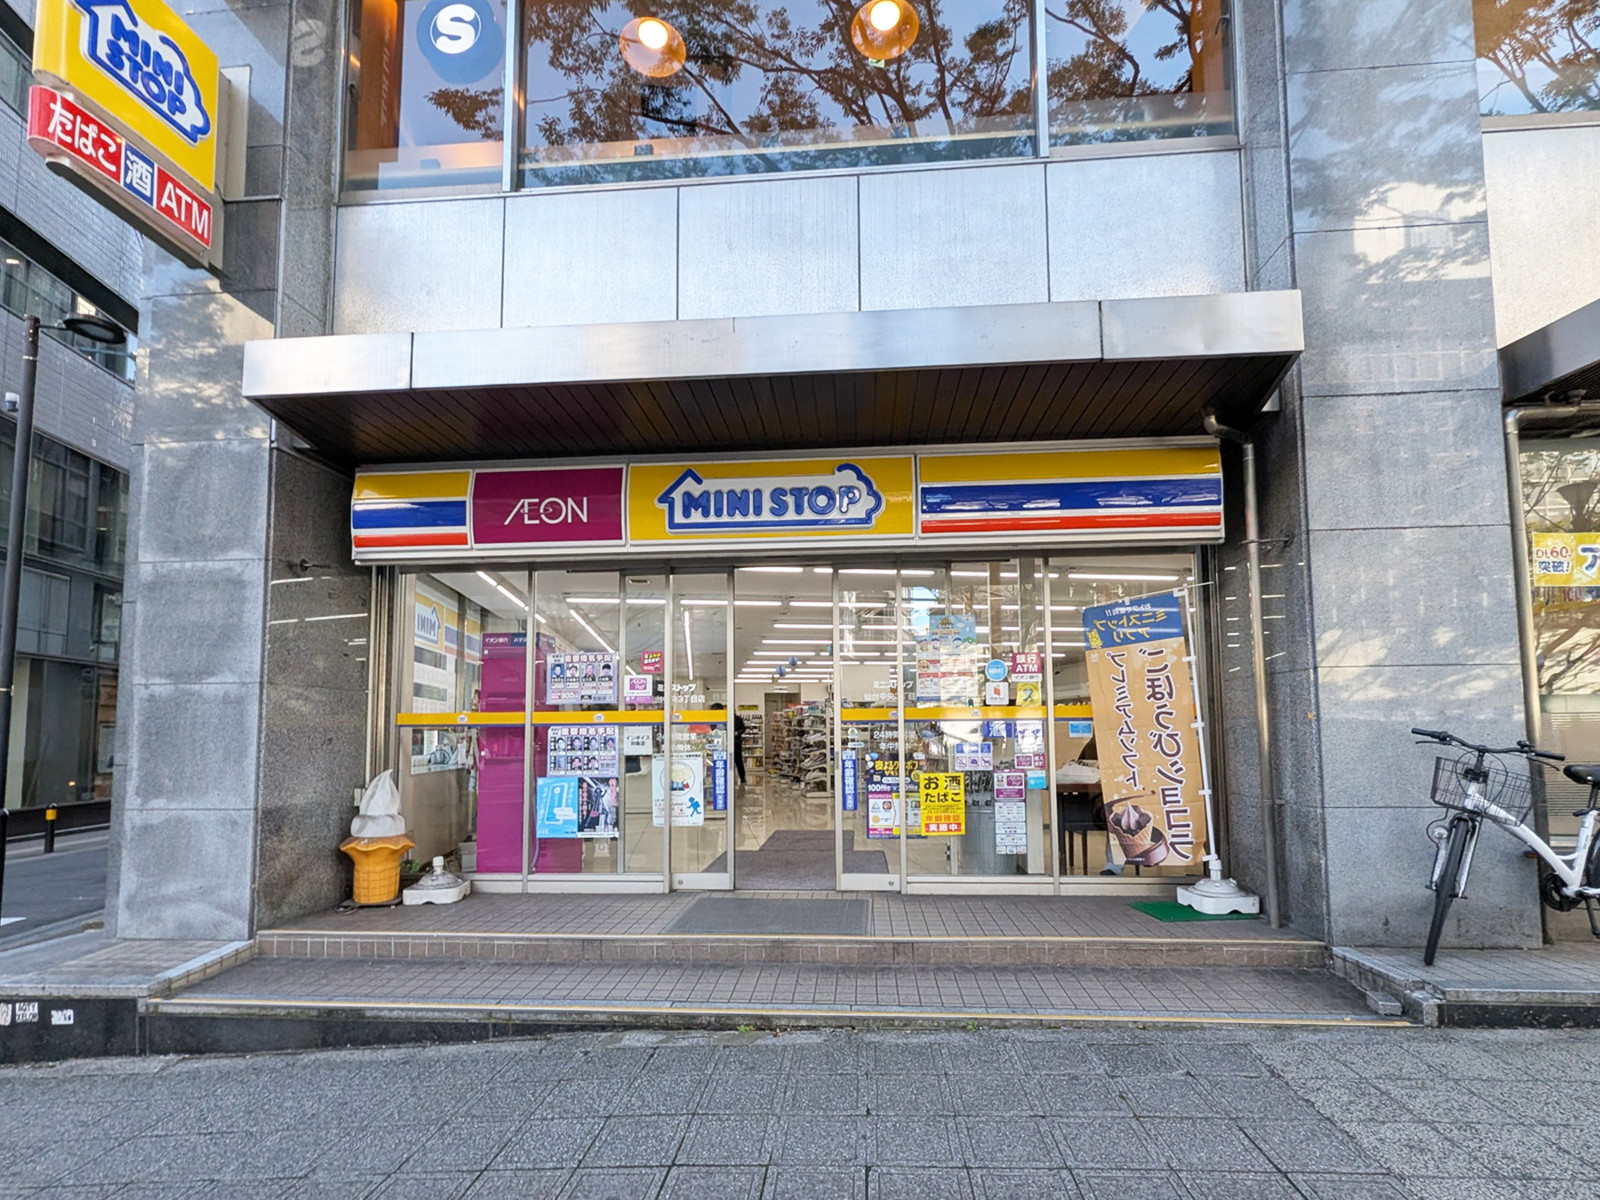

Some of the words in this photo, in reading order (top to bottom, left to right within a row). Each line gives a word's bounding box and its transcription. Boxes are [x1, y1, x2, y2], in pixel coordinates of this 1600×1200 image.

[110, 13, 185, 95] MINI
[434, 3, 478, 54] S
[105, 38, 188, 115] STOP
[47, 100, 118, 173] たばこ
[125, 151, 154, 198] 酒
[160, 182, 209, 239] ATM
[682, 488, 763, 519] MINI
[769, 485, 862, 518] STOP
[1016, 664, 1038, 673] ATM
[924, 791, 962, 803] たばこ
